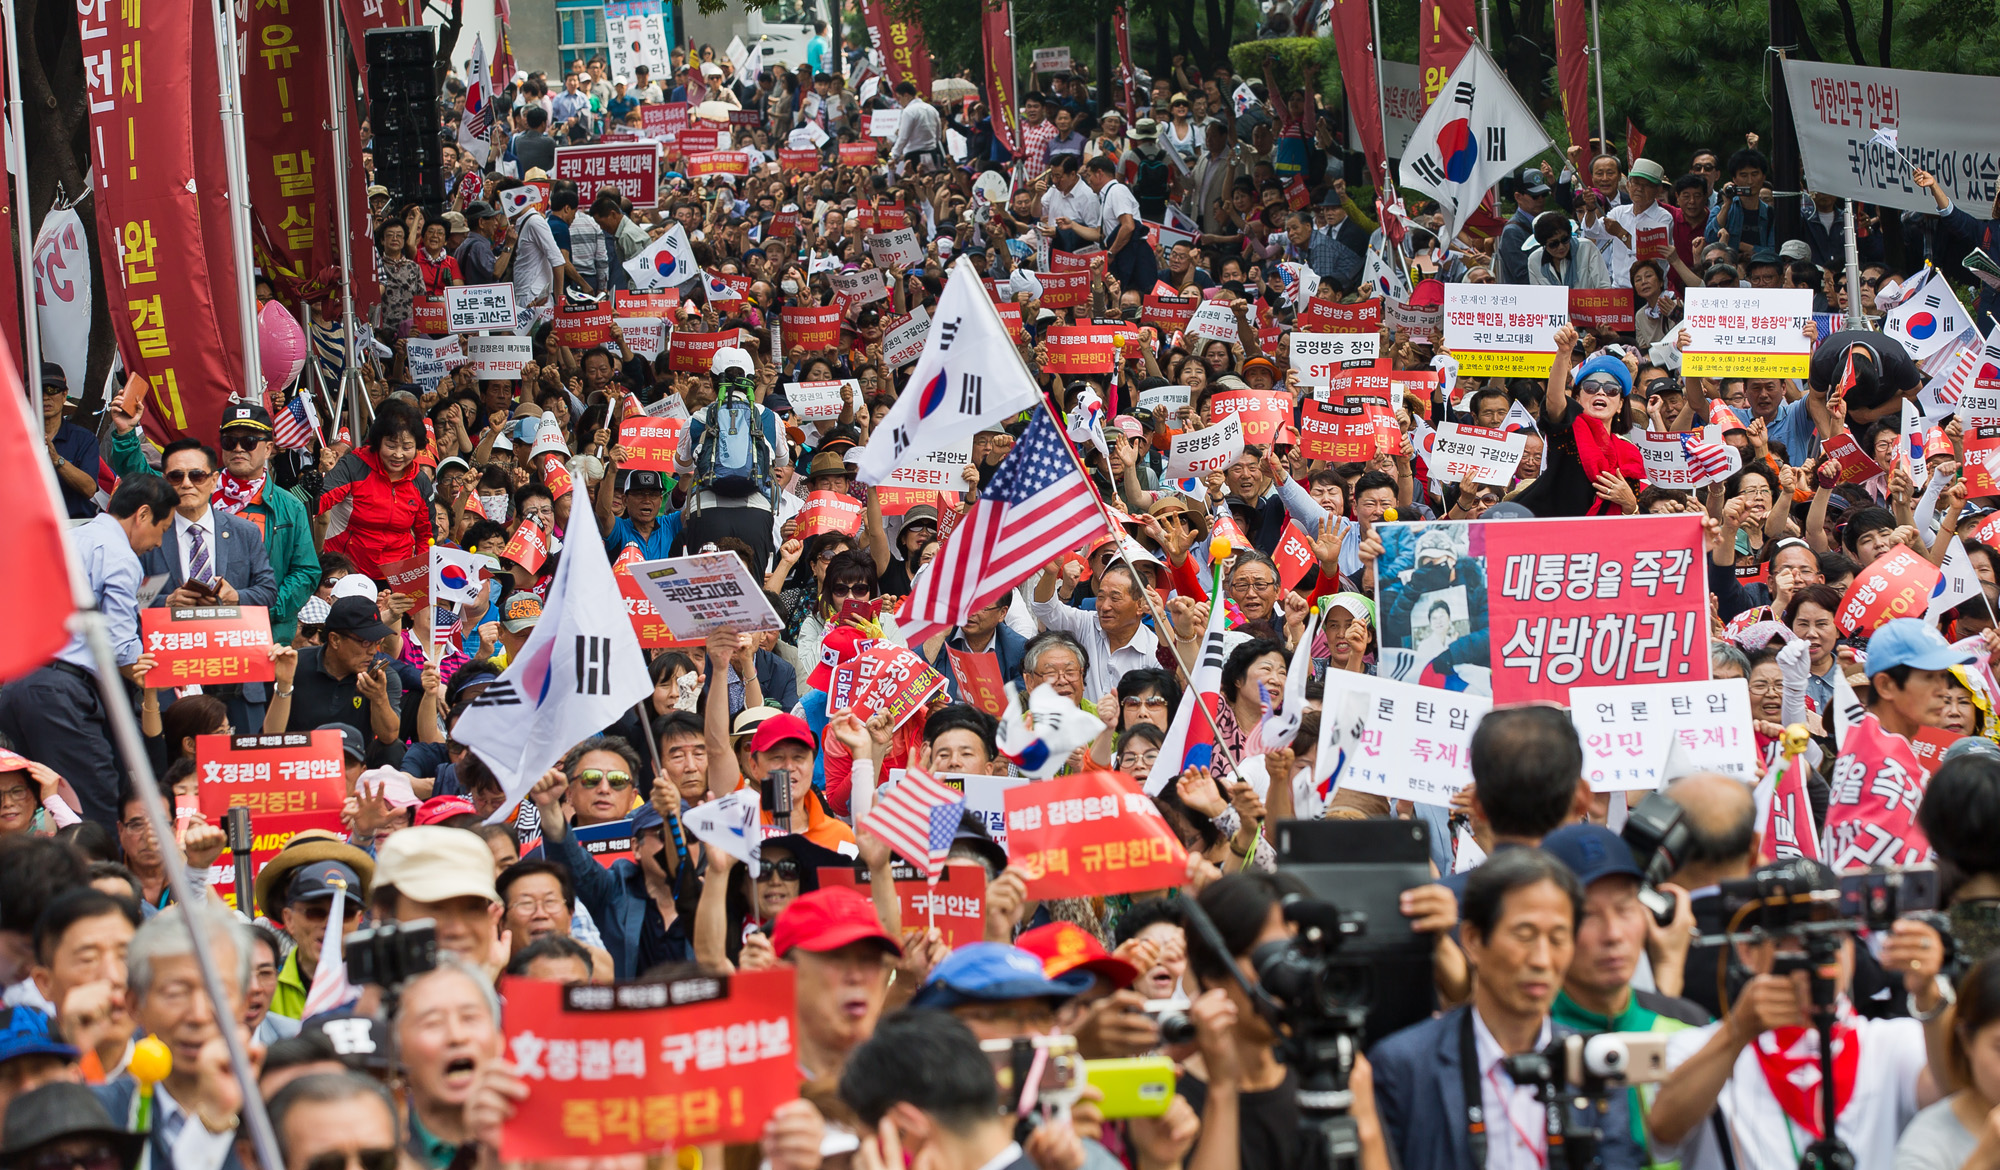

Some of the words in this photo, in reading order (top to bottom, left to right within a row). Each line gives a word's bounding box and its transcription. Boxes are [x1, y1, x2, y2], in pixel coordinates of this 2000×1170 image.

[1811, 77, 1863, 128] 대한민국
[1867, 82, 1899, 129] 안보!
[561, 159, 581, 178] 국민
[585, 158, 606, 176] 지킬
[609, 155, 652, 173] 북핵대책
[894, 233, 912, 244] 장악
[879, 250, 909, 262] STOP!
[1054, 254, 1086, 267] 공영방송
[730, 279, 748, 291] 장악
[861, 273, 878, 285] 장악
[1070, 276, 1086, 287] 장악
[457, 296, 506, 310] 보은·옥천
[619, 299, 647, 308] 文정권의
[651, 299, 678, 307] 구걸안보
[1043, 293, 1079, 304] STOP!
[1460, 295, 1487, 304] 문재인
[1491, 295, 1517, 305] 정권의
[1700, 299, 1729, 309] 문재인
[1734, 299, 1760, 309] 정권의
[453, 311, 511, 325] 영동·괴산군
[793, 314, 816, 324] 김정은의
[1144, 306, 1174, 317] 文정권의
[1313, 304, 1353, 320] 공영방송
[1359, 306, 1377, 319] 장악
[1387, 306, 1416, 323] 文정권의
[555, 314, 580, 328] 文정권의
[584, 314, 612, 325] 구걸안보
[1447, 312, 1474, 326] "5천만
[1476, 313, 1506, 328] 핵인질,
[1687, 315, 1716, 329] "5천만
[1718, 315, 1748, 330] 핵인질,
[802, 331, 837, 342] 규탄한다!
[903, 319, 931, 340] 구걸안보
[1199, 323, 1239, 339] 즉각중단!
[688, 341, 715, 349] 김정은의
[1059, 335, 1088, 344] 김정은의
[1090, 334, 1113, 344] 핵개발을
[1473, 333, 1492, 344] 국민
[1495, 333, 1534, 344] 보고대회
[1713, 335, 1733, 346] 국민
[1736, 335, 1776, 346] 보고대회
[507, 344, 531, 352] 핵개발을
[889, 339, 927, 365] 즉각중단!
[1296, 341, 1344, 355] 공영방송
[1351, 341, 1374, 354] 장악
[1051, 353, 1067, 364] 강력
[1071, 352, 1111, 365] 규탄한다!
[1737, 356, 1751, 364] 13시
[1331, 377, 1351, 391] 文정권의
[1355, 376, 1389, 388] 구걸안보
[789, 392, 823, 403] 文정권의
[1163, 395, 1189, 404] 핵개발을
[1214, 398, 1260, 414] 공영방송
[1267, 397, 1289, 413] 장악
[622, 428, 637, 437] 북한
[640, 427, 671, 438] 김정은의
[1302, 416, 1339, 435] 文정권의
[1176, 433, 1220, 454] 공영방송
[1224, 421, 1239, 441] 장악
[626, 447, 646, 460] 강력
[1310, 440, 1367, 457] 즉각중단!
[1436, 438, 1475, 456] 文정권의
[1480, 446, 1519, 464] 구걸안보
[926, 451, 968, 464] 구걸안보
[1188, 451, 1232, 472] STOP!
[891, 468, 949, 484] 즉각중단!
[878, 492, 899, 505] 강력
[809, 515, 852, 529] 규탄한다!
[1284, 536, 1312, 567] 장악
[1883, 552, 1918, 577] 장악
[401, 565, 429, 581] 김정은의
[1501, 551, 1623, 603] 대통령을
[1630, 548, 1694, 597] 즉각
[663, 581, 744, 603] 국민보고대회
[1841, 576, 1889, 632] 공영방송
[149, 631, 207, 652] 文정권의
[214, 631, 269, 647] 구걸안보
[1501, 611, 1698, 686] 석방하라!
[172, 656, 249, 678] 즉각중단!
[835, 669, 853, 709] 문재인
[863, 651, 923, 714] 방송장악
[1586, 731, 1643, 758] 인민
[1679, 726, 1738, 750] 독재!
[1410, 737, 1470, 770] 독재!
[203, 761, 271, 784] 文정권의
[279, 759, 342, 780] 구걸안보
[1008, 805, 1043, 832] 북한
[1047, 794, 1119, 826] 김정은의
[1025, 848, 1070, 880] 강력
[910, 895, 981, 920] 구걸안보
[322, 1018, 377, 1054] H
[510, 1030, 646, 1081] 文정권의
[660, 1016, 792, 1074] 구걸안보
[561, 1086, 745, 1145] 즉각중단!
